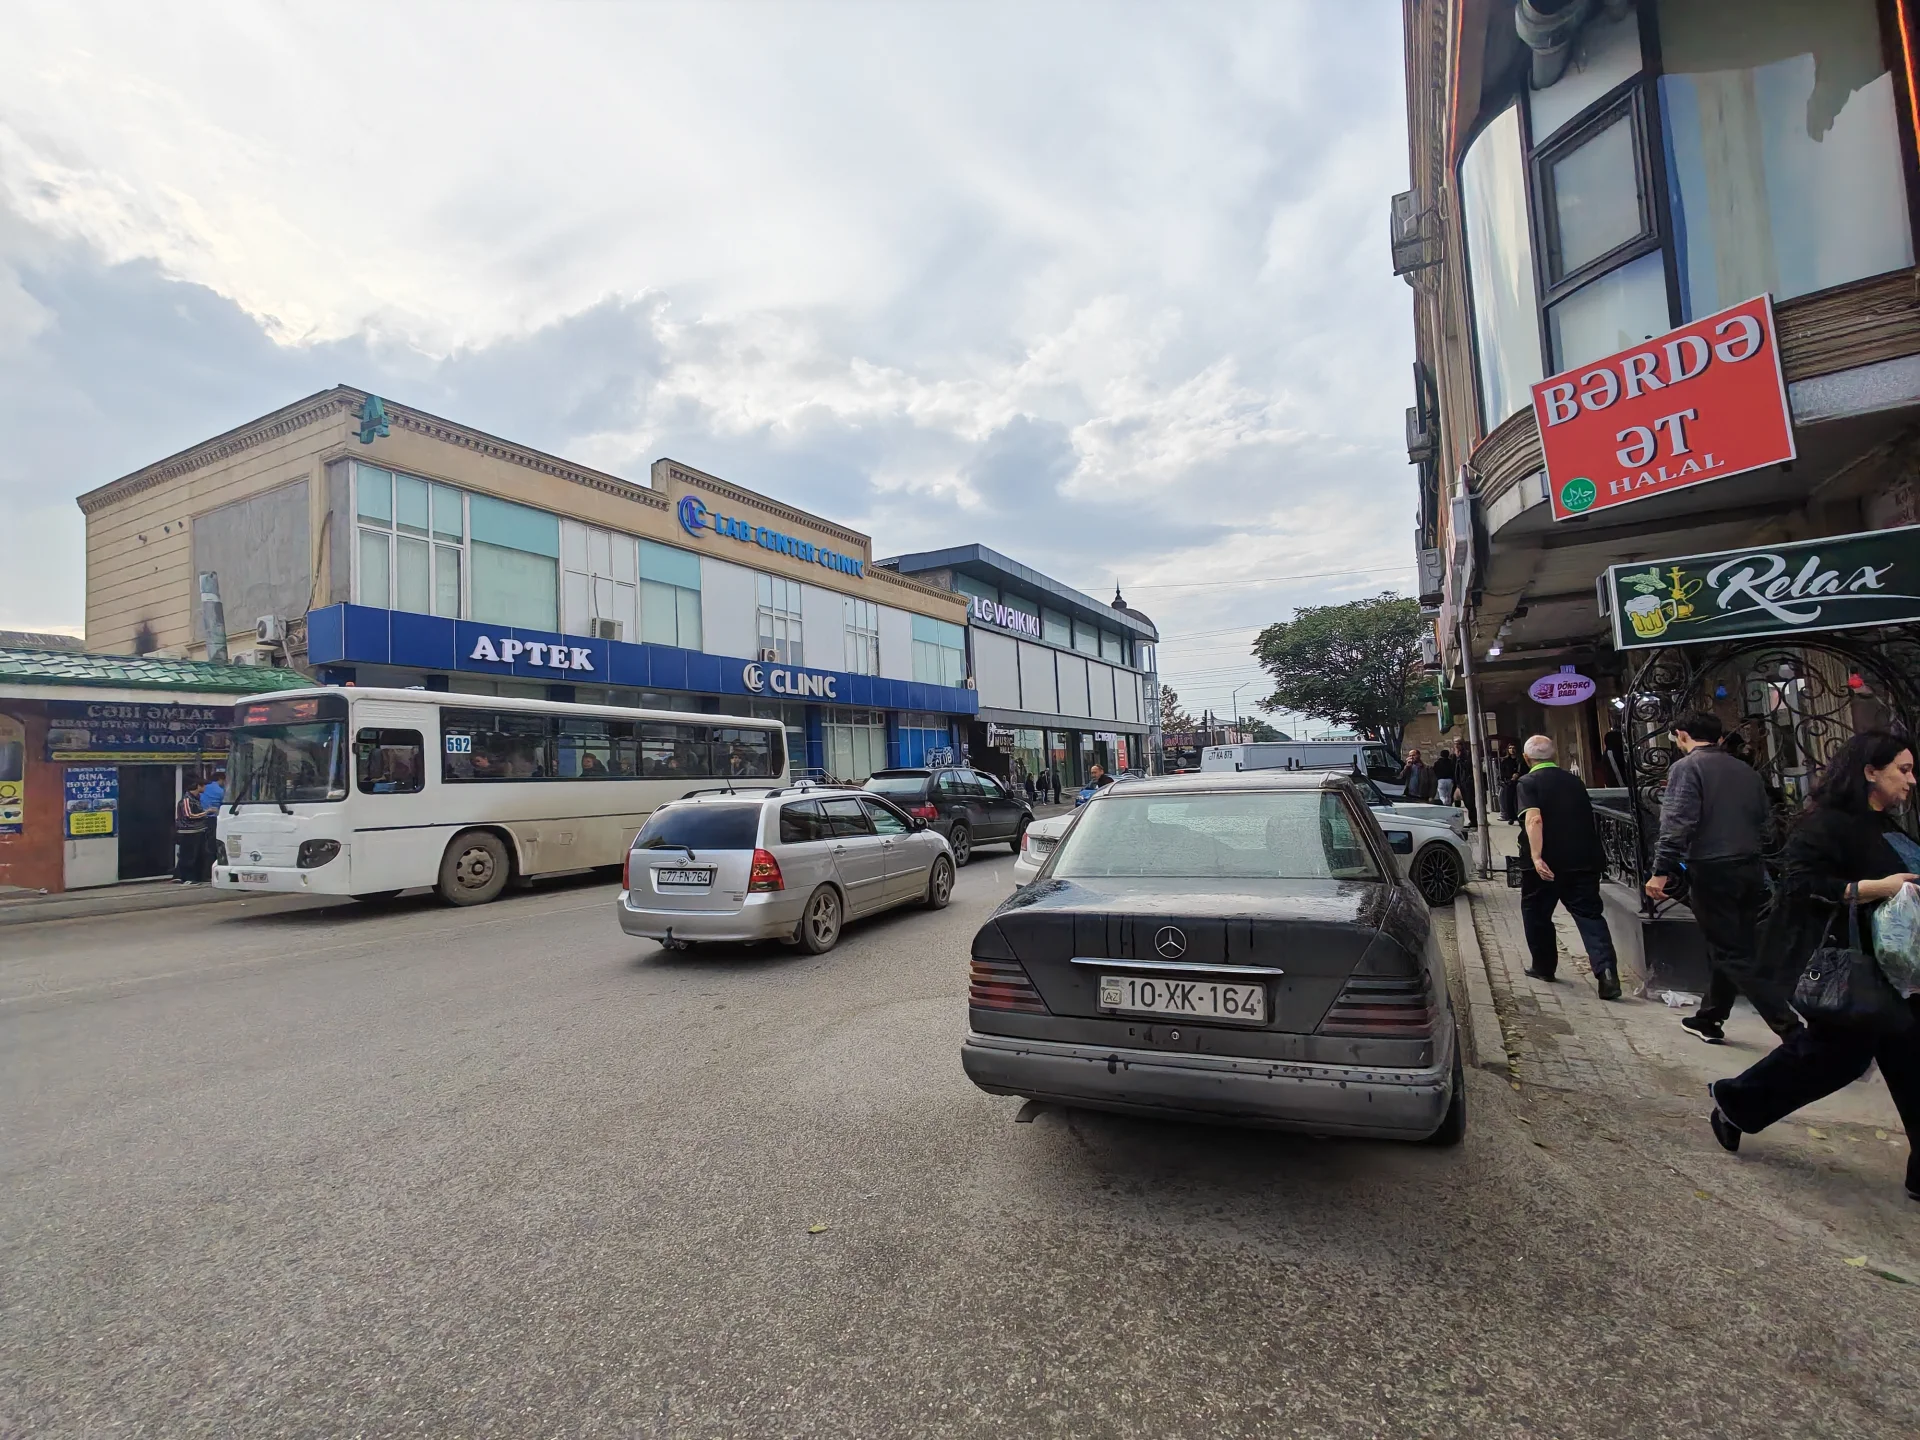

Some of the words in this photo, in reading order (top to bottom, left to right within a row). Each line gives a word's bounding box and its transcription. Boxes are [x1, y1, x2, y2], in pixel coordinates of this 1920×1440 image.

[1541, 314, 1764, 427] BƏRDƏ
[1615, 408, 1698, 468] ƏT
[1608, 453, 1725, 495] HALAL
[715, 513, 752, 542] LAB
[756, 526, 816, 563] CENTER
[819, 547, 865, 579] CLINIC
[972, 596, 992, 621] LC
[1706, 553, 1894, 624] Relax
[469, 635, 594, 671] APTEK
[770, 669, 837, 698] CLINIC
[447, 737, 470, 752] 592
